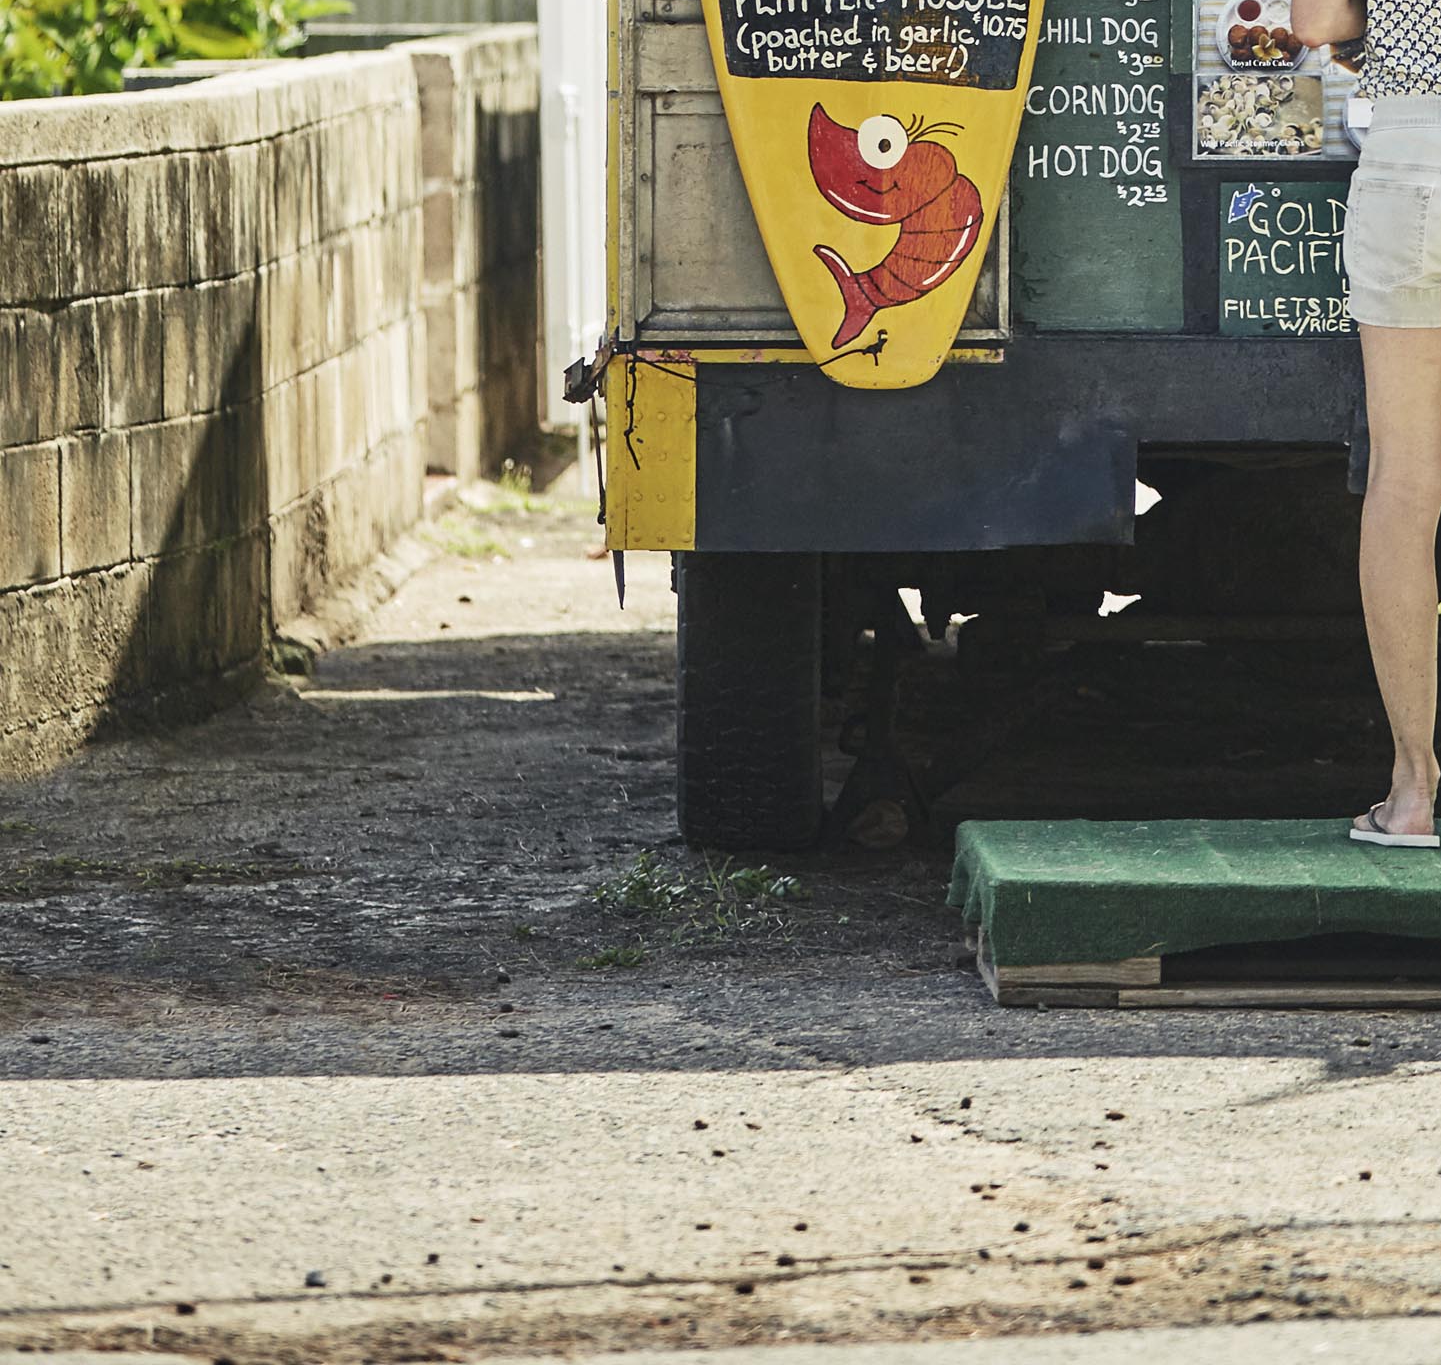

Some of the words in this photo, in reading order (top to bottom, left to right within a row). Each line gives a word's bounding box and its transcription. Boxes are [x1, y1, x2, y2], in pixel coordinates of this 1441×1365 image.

[736, 18, 862, 60] (poached
[871, 18, 893, 43] in
[1101, 17, 1158, 47] DOG
[767, 47, 847, 73] butter
[863, 49, 879, 73] &
[885, 45, 968, 80] beer!)
[1231, 60, 1252, 68] Royal
[1253, 59, 1271, 67] Crab
[1028, 145, 1093, 178] HOT
[1099, 144, 1163, 179] DOG
